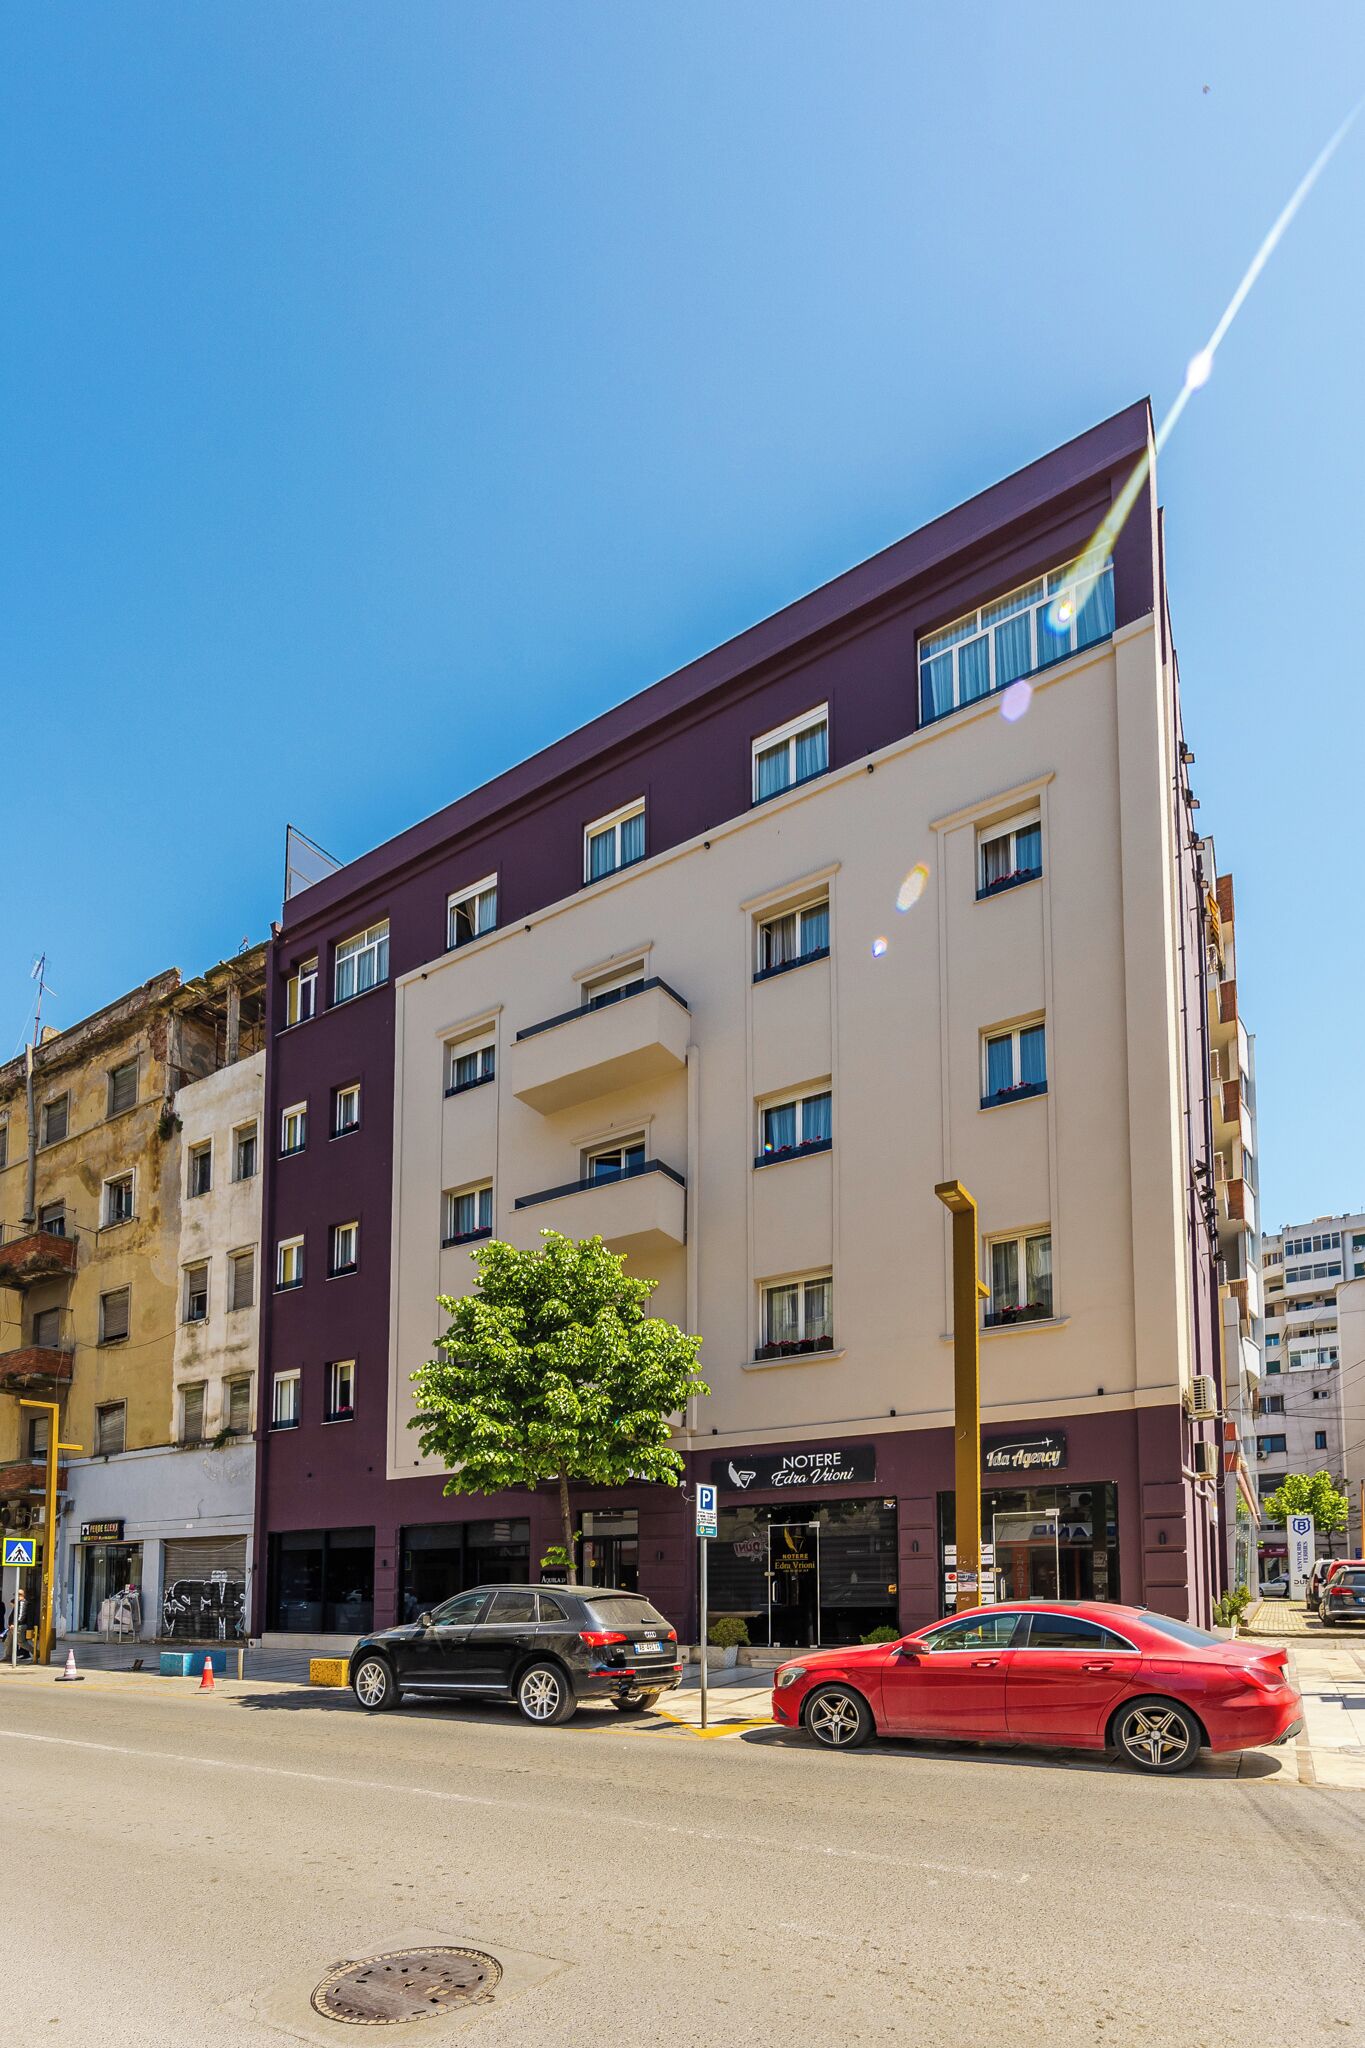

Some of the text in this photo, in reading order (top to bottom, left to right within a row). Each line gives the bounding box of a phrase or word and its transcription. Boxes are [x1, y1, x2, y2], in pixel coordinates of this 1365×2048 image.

[782, 1452, 841, 1469] NOTERE
[986, 1449, 1061, 1468] Ida Agency
[771, 1467, 854, 1486] Edra Vrioni
[702, 1490, 711, 1508] P
[1297, 1521, 1307, 1531] B
[792, 1561, 816, 1569] Vrioni
